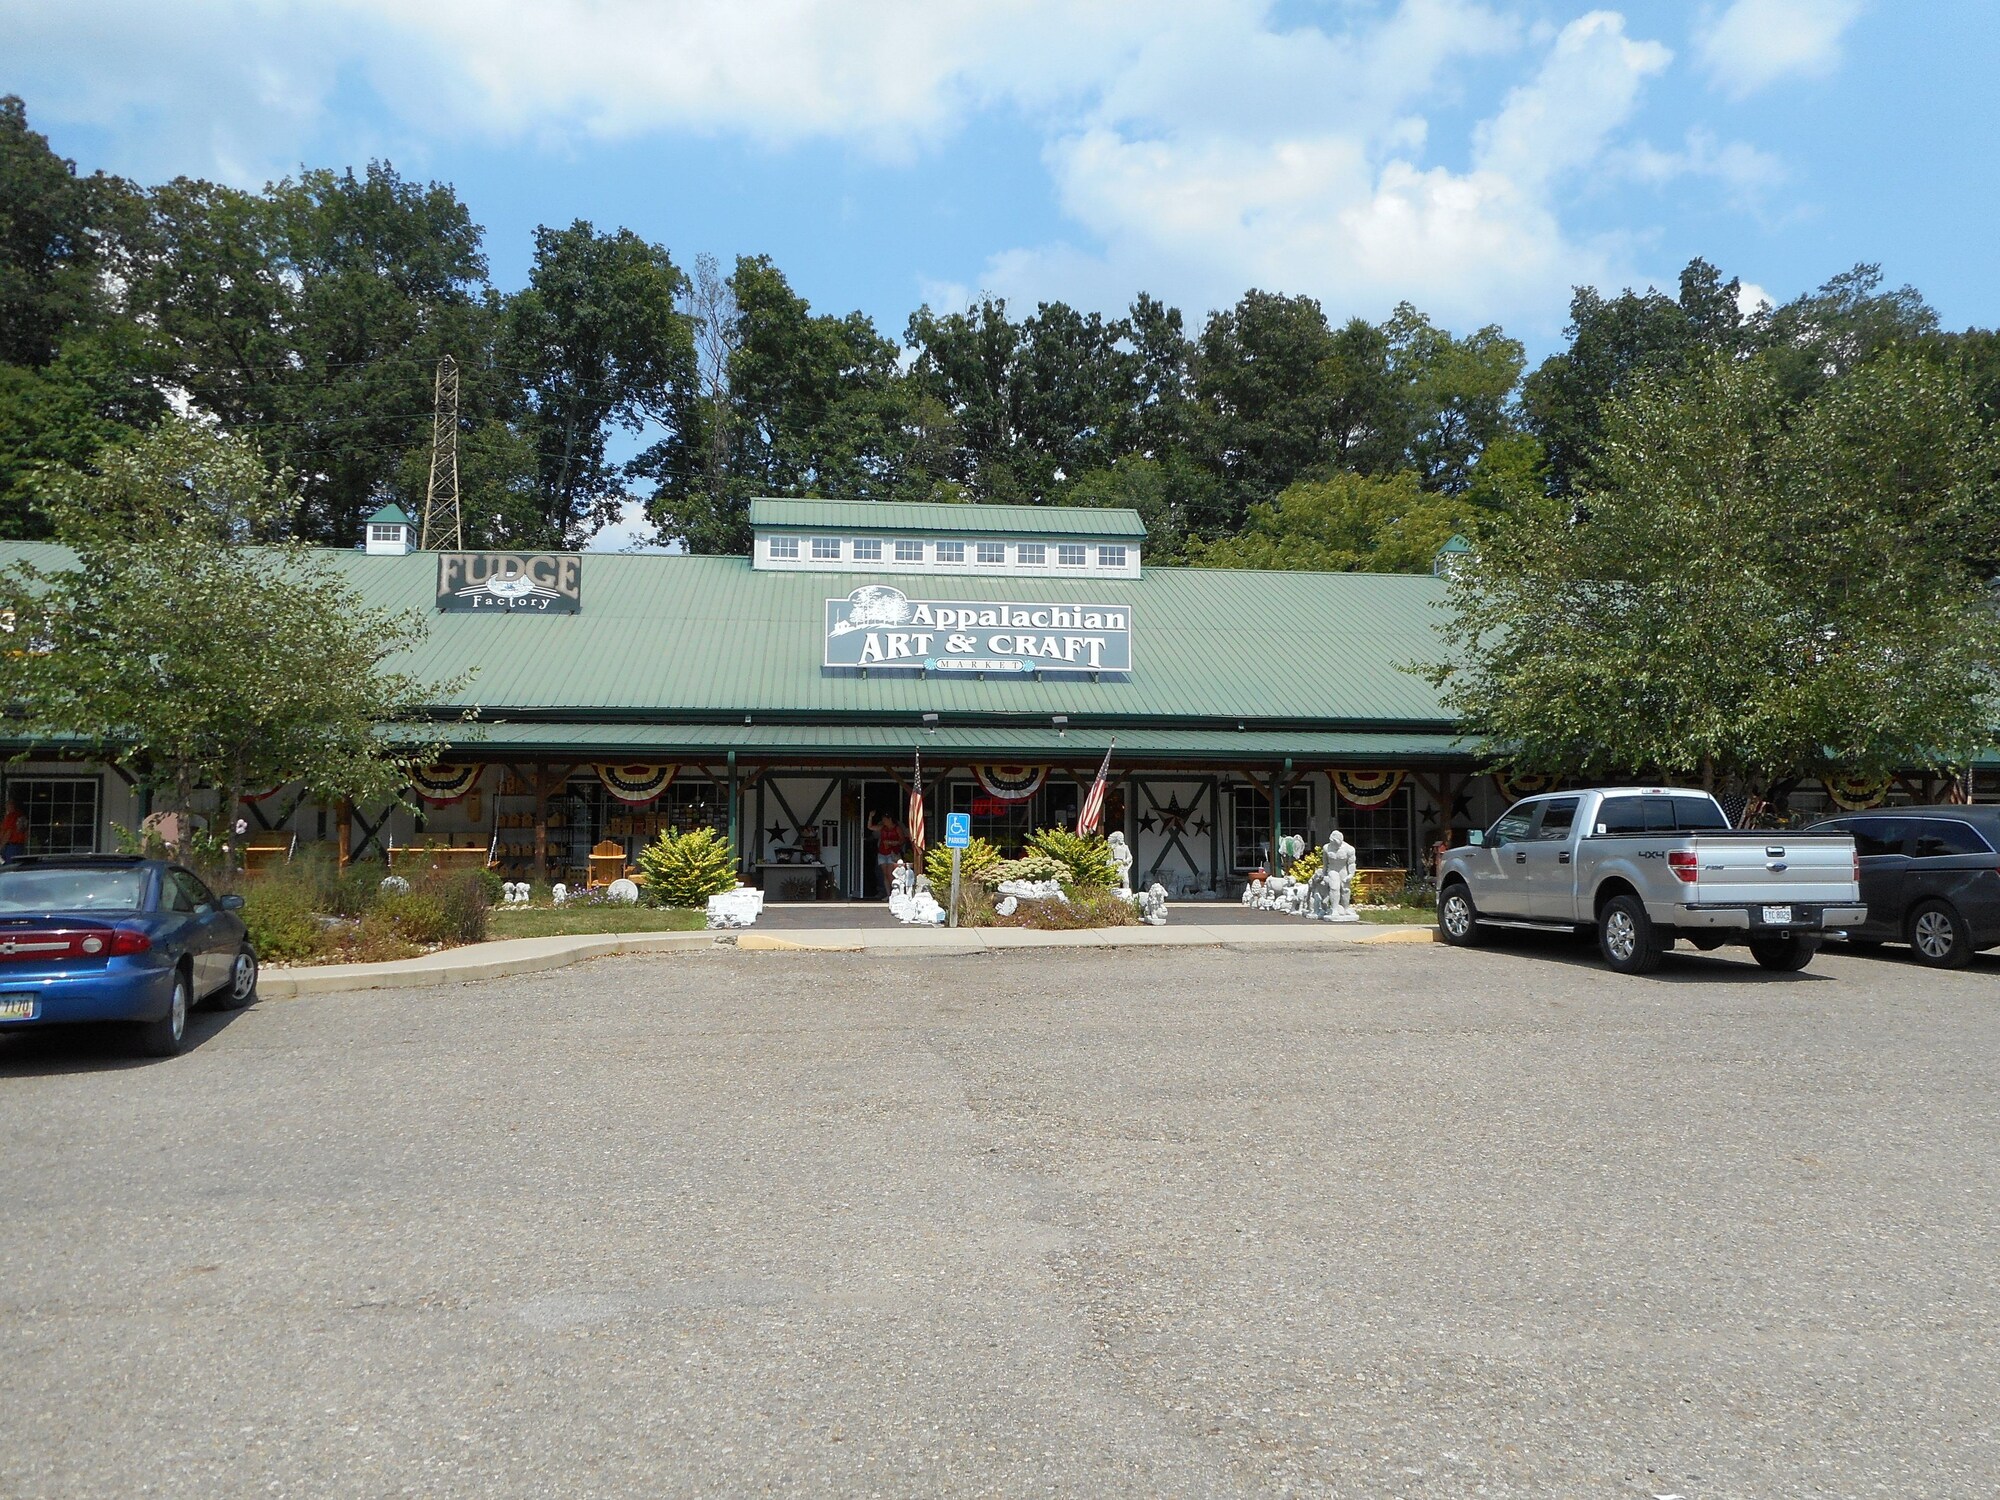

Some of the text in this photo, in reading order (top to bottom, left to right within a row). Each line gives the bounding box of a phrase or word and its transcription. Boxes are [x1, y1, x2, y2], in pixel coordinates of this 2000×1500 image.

[438, 553, 580, 600] FUDGE
[472, 595, 550, 609] Factory
[909, 604, 1126, 631] Appalachian
[857, 633, 1106, 669] ART & CRAFT
[940, 660, 1019, 669] MARKET
